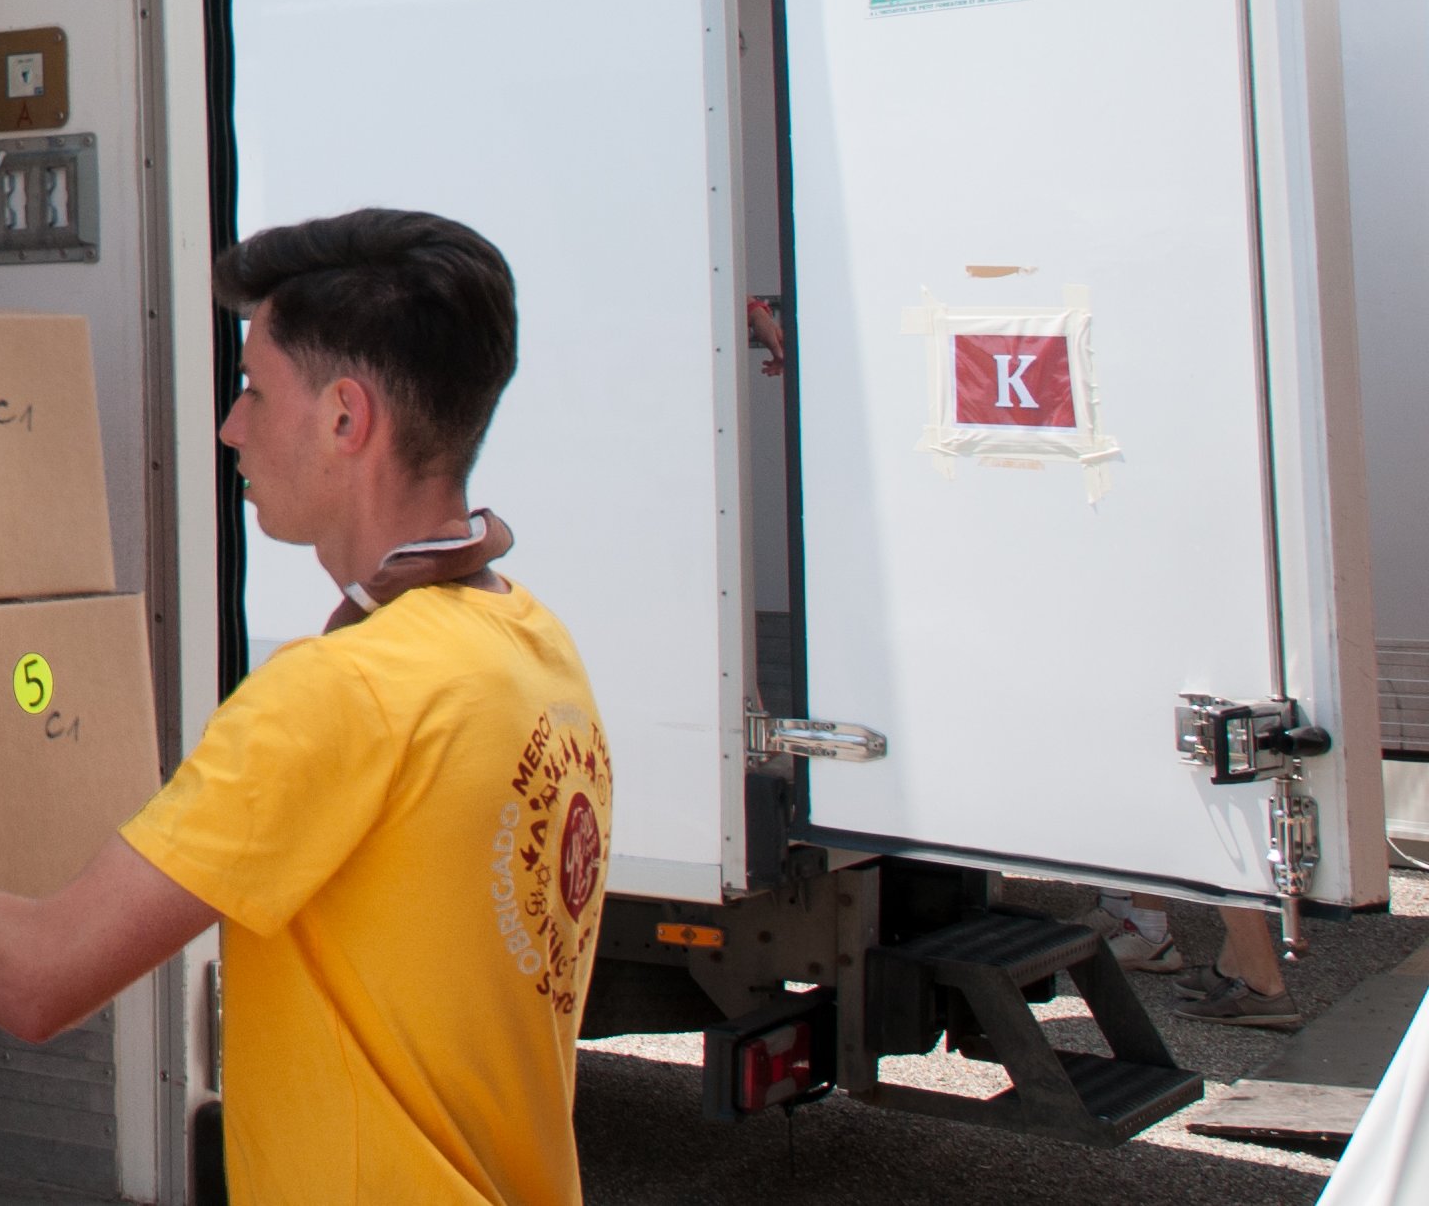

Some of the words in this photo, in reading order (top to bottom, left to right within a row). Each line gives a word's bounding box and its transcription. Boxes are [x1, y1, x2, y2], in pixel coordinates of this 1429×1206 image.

[993, 354, 1039, 409] K
[23, 658, 45, 708] 5
[44, 710, 81, 744] C1
[511, 712, 553, 797] MERCI
